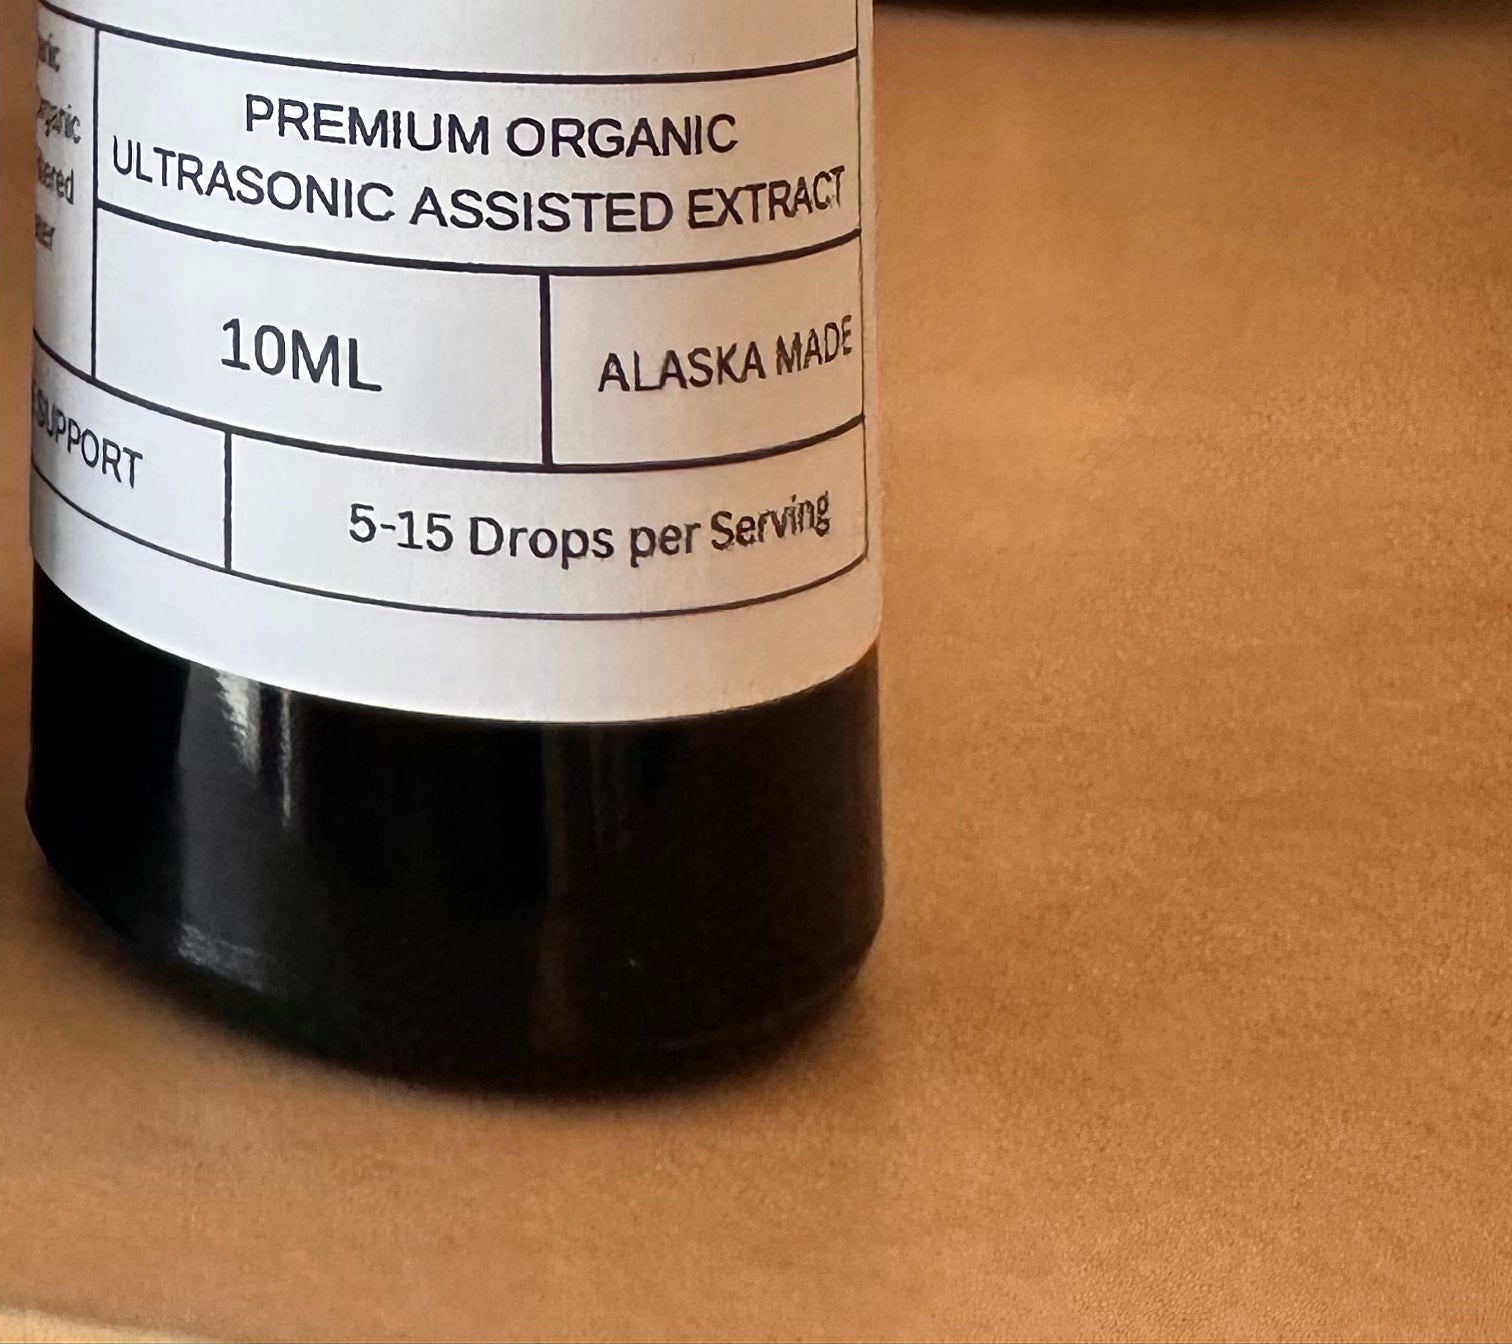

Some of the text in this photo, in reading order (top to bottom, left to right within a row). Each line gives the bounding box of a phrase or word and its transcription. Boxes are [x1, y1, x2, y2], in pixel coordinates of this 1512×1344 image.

[245, 93, 740, 160] PREMIUM ORGANIC
[112, 137, 845, 234] ULTRASONIC ASSISTED EXTRACT
[220, 318, 383, 393] 10ML
[597, 314, 853, 393] ALASKA MADE
[349, 489, 832, 571] 5-15 Drops per Serving
